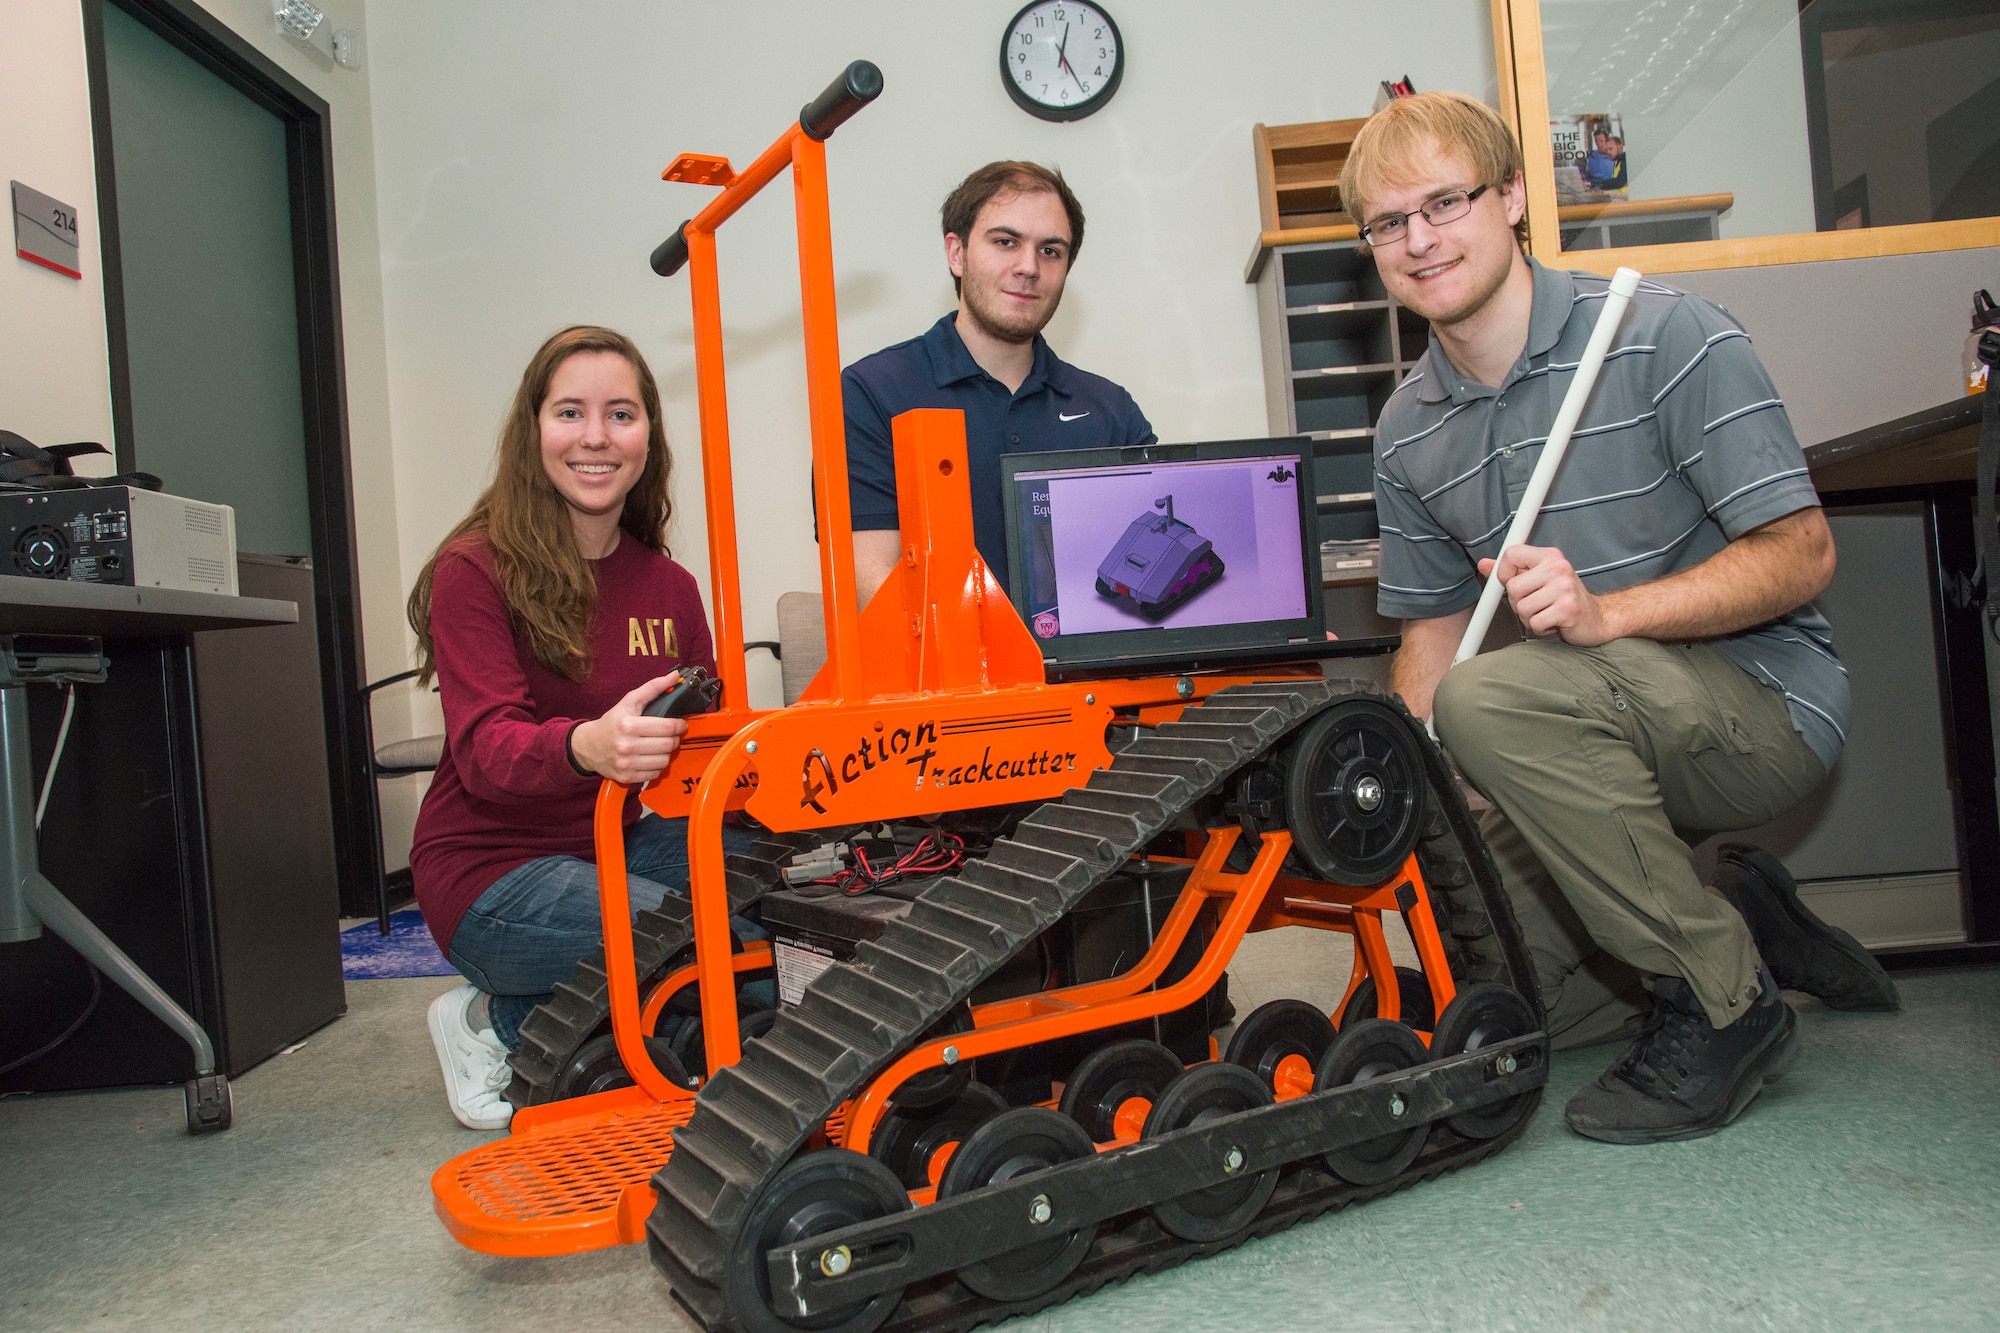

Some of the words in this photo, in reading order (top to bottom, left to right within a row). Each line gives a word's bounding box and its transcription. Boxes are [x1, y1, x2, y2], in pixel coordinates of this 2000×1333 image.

[1053, 10, 1065, 21] 12
[1035, 17, 1044, 28] 11
[1021, 33, 1032, 45] 10
[1094, 28, 1102, 40] 2
[1018, 53, 1026, 64] 9
[1098, 48, 1107, 59] 3
[1024, 70, 1032, 81] 8
[1094, 66, 1102, 77] 4
[1041, 84, 1049, 95] 7
[1082, 81, 1090, 93] 5
[1060, 89, 1068, 99] 6
[1553, 133, 1580, 141] THE
[1554, 142, 1576, 150] BIG
[1554, 151, 1594, 160] BOOK
[53, 209, 76, 234] 214
[800, 719, 938, 815] Action
[906, 746, 1078, 791] Trackcutter
